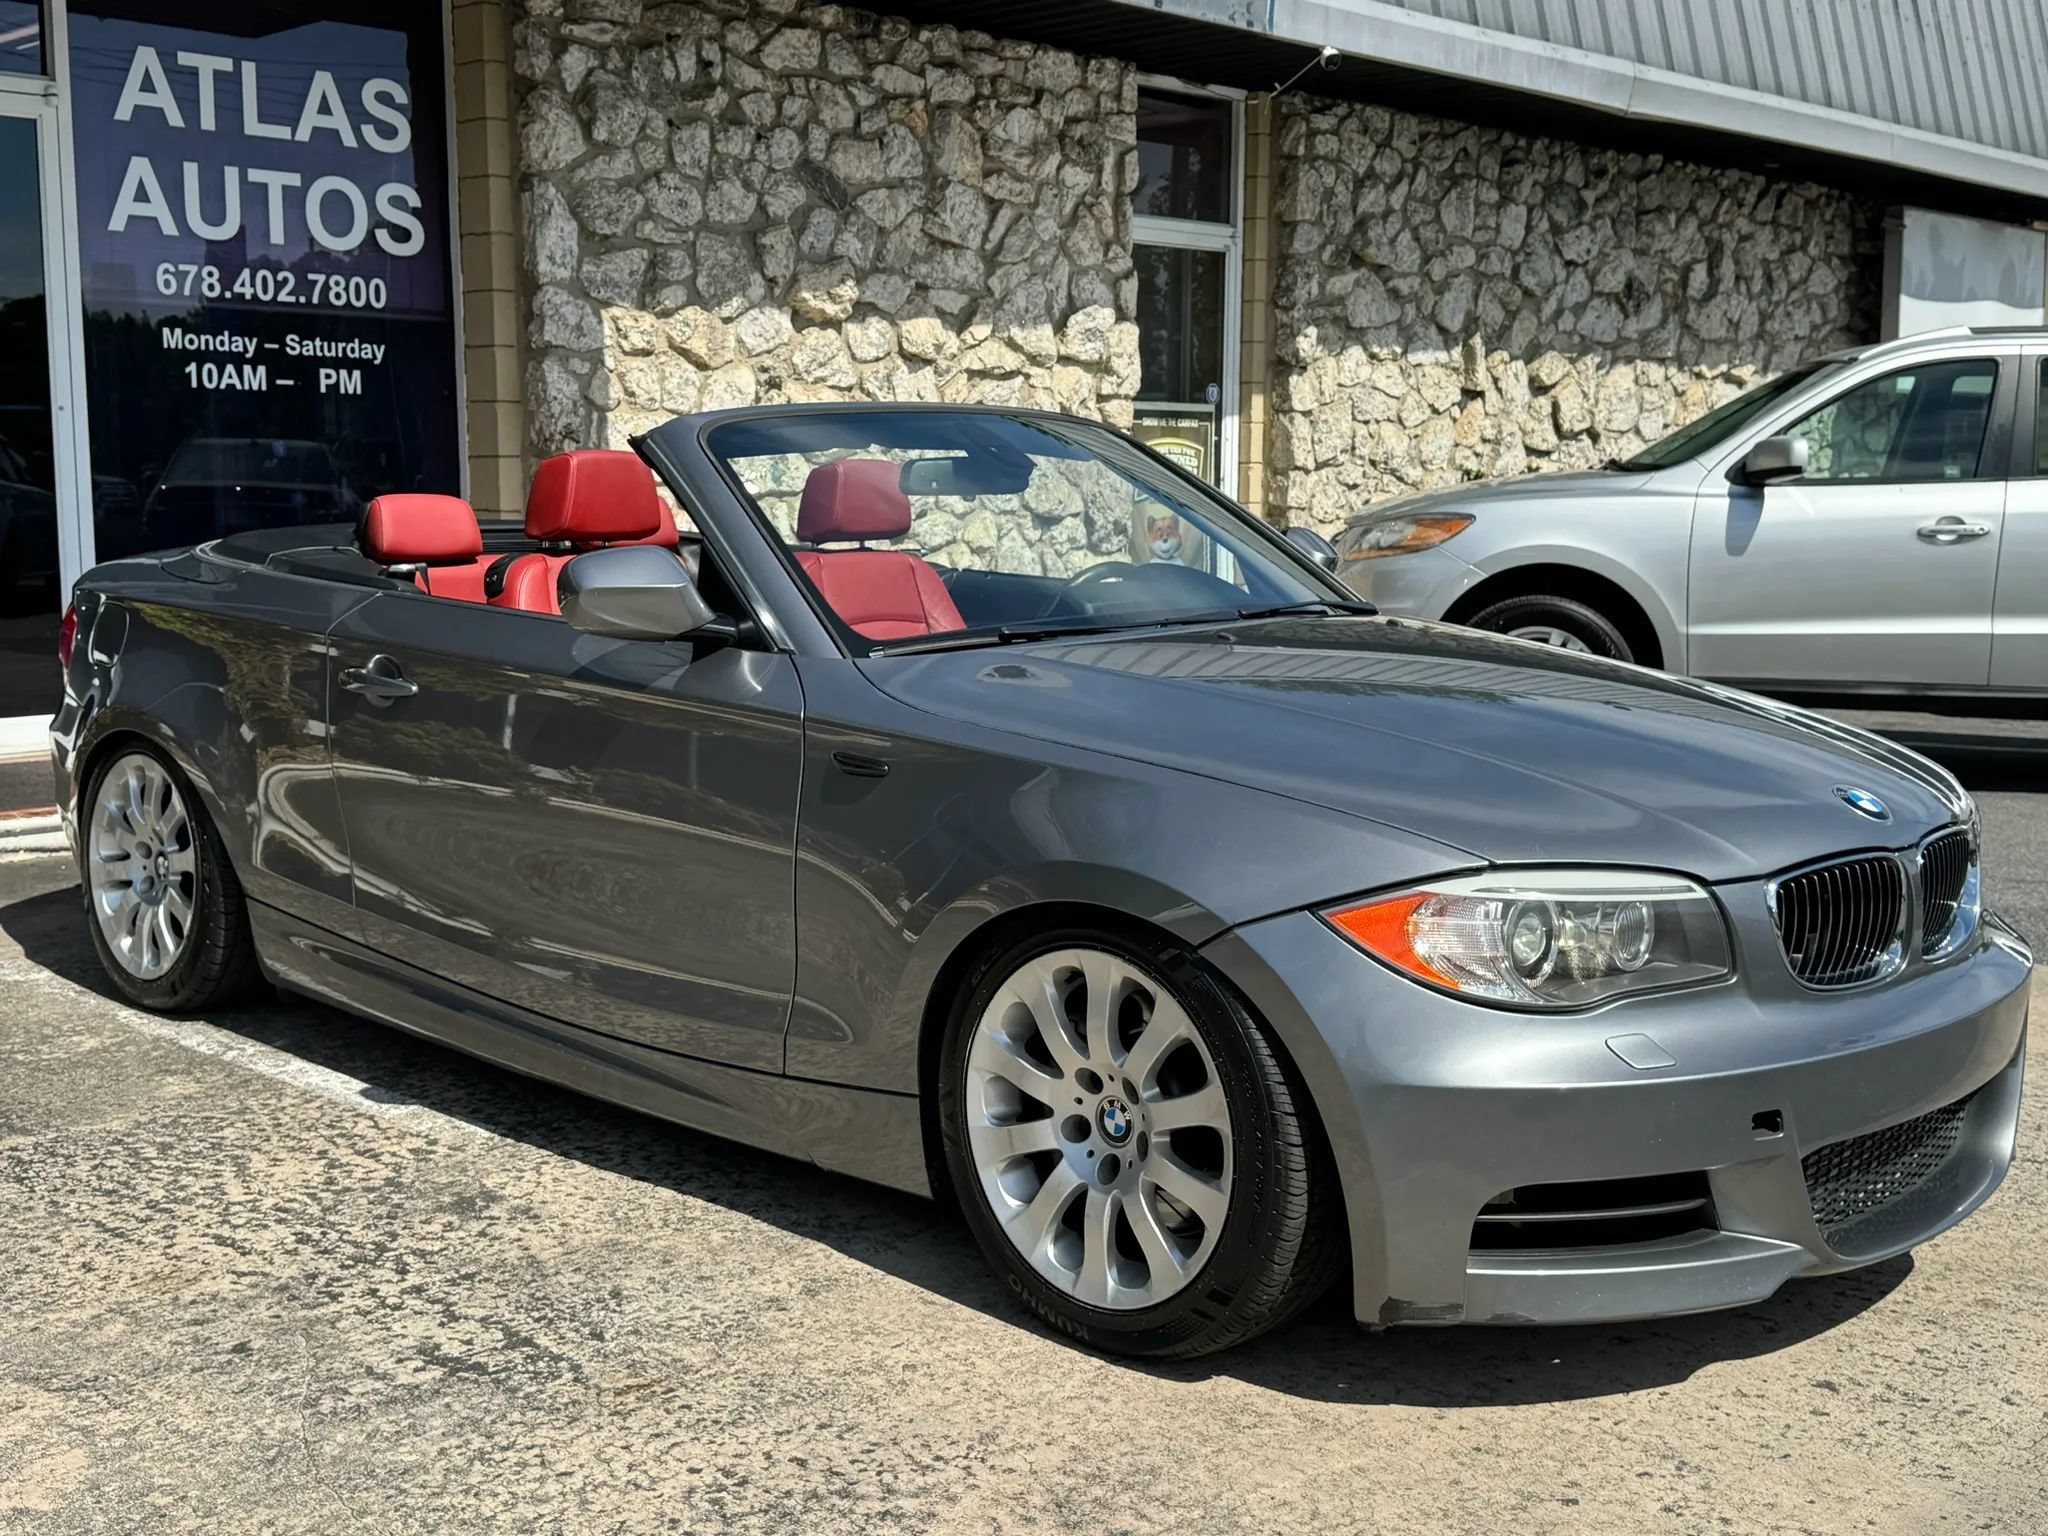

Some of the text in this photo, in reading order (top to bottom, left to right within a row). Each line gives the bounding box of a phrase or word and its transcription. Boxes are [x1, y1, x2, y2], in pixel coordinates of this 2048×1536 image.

[113, 45, 412, 153] ATLAS
[107, 156, 425, 257] AUTOS
[156, 262, 387, 309] 678.402.7800
[162, 327, 257, 358] Monday
[285, 334, 385, 364] Saturday
[185, 362, 267, 391] 10AM
[319, 368, 362, 395] PM
[1177, 418, 1199, 428] CARFAX
[1103, 1100, 1131, 1120] BMW
